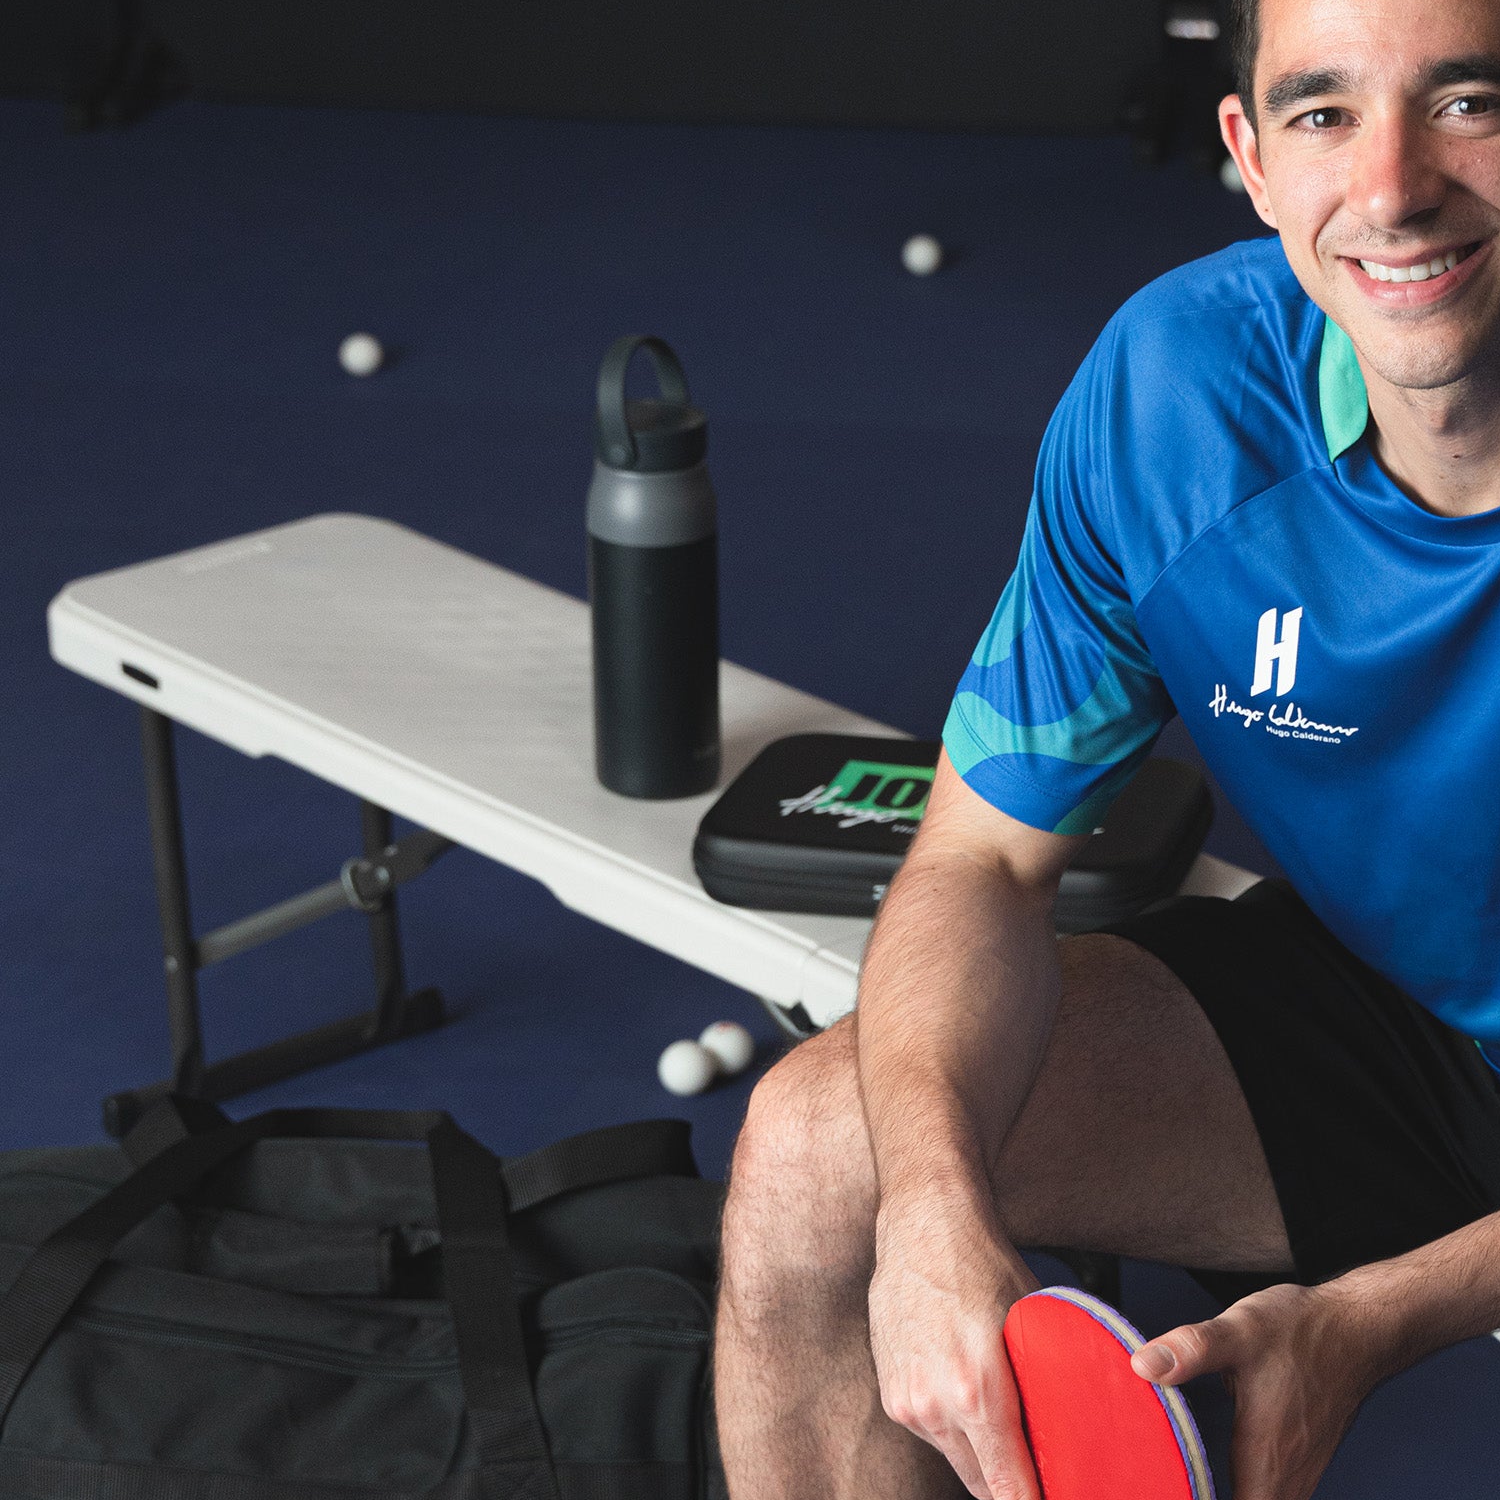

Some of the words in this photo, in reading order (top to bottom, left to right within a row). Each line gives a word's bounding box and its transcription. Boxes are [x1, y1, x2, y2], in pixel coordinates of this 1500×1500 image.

[1250, 606, 1303, 697] H
[1208, 683, 1265, 728] Hugo
[1266, 725, 1290, 738] Hugo
[1292, 730, 1342, 744] Calderano
